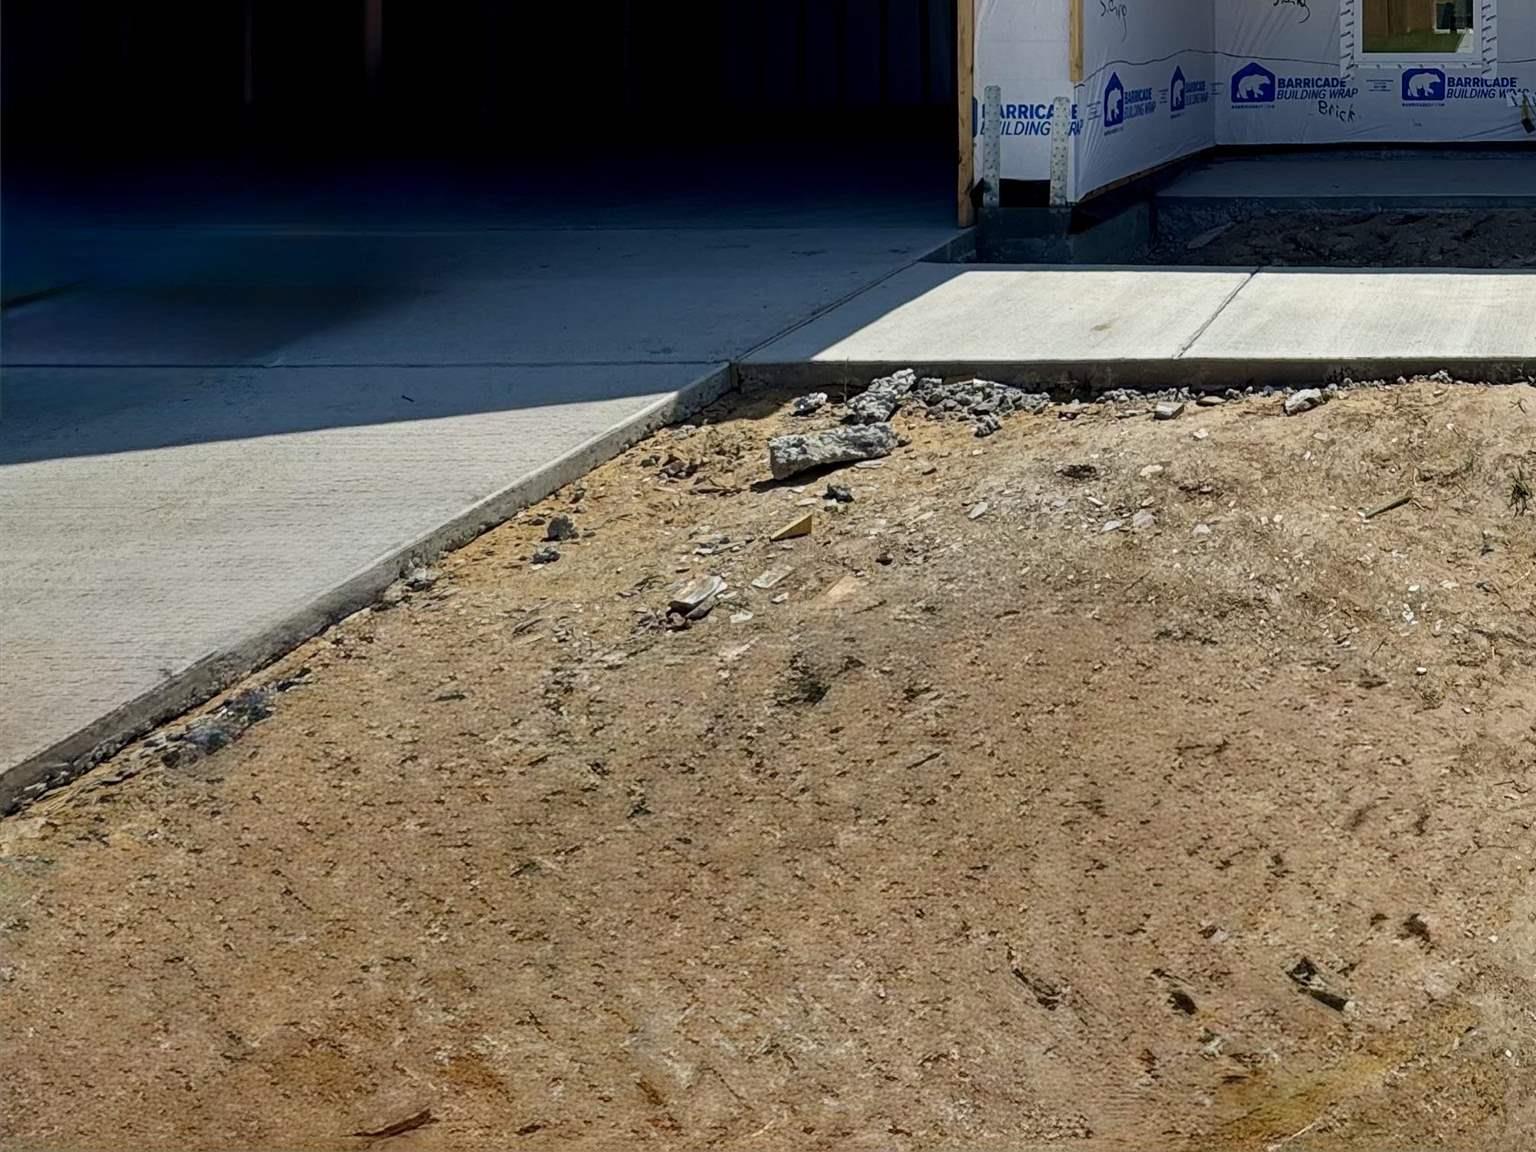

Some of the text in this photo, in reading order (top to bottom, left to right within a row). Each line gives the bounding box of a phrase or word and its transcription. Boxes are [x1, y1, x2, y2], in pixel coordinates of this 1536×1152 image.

[1278, 77, 1346, 88] BARRICADE
[1447, 77, 1518, 88] BARRICADE
[1277, 88, 1358, 100] BUILDING WRAP
[1447, 87, 1497, 99] BUILDING
